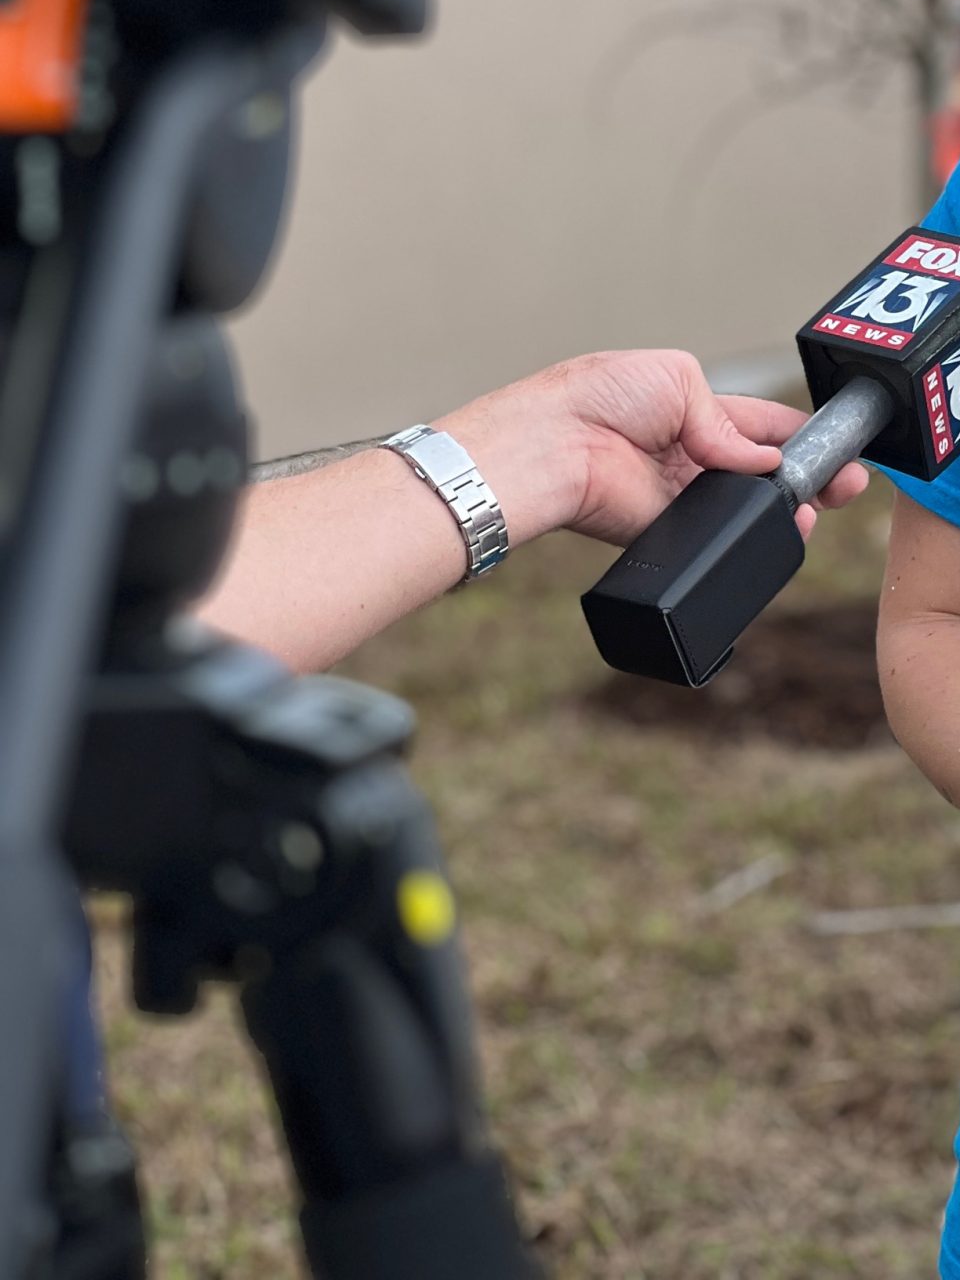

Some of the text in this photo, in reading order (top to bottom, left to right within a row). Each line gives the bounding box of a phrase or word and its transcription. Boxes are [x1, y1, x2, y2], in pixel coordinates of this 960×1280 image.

[850, 270, 949, 324] 13
[820, 318, 906, 346] NEWS
[926, 371, 948, 455] NEWS
